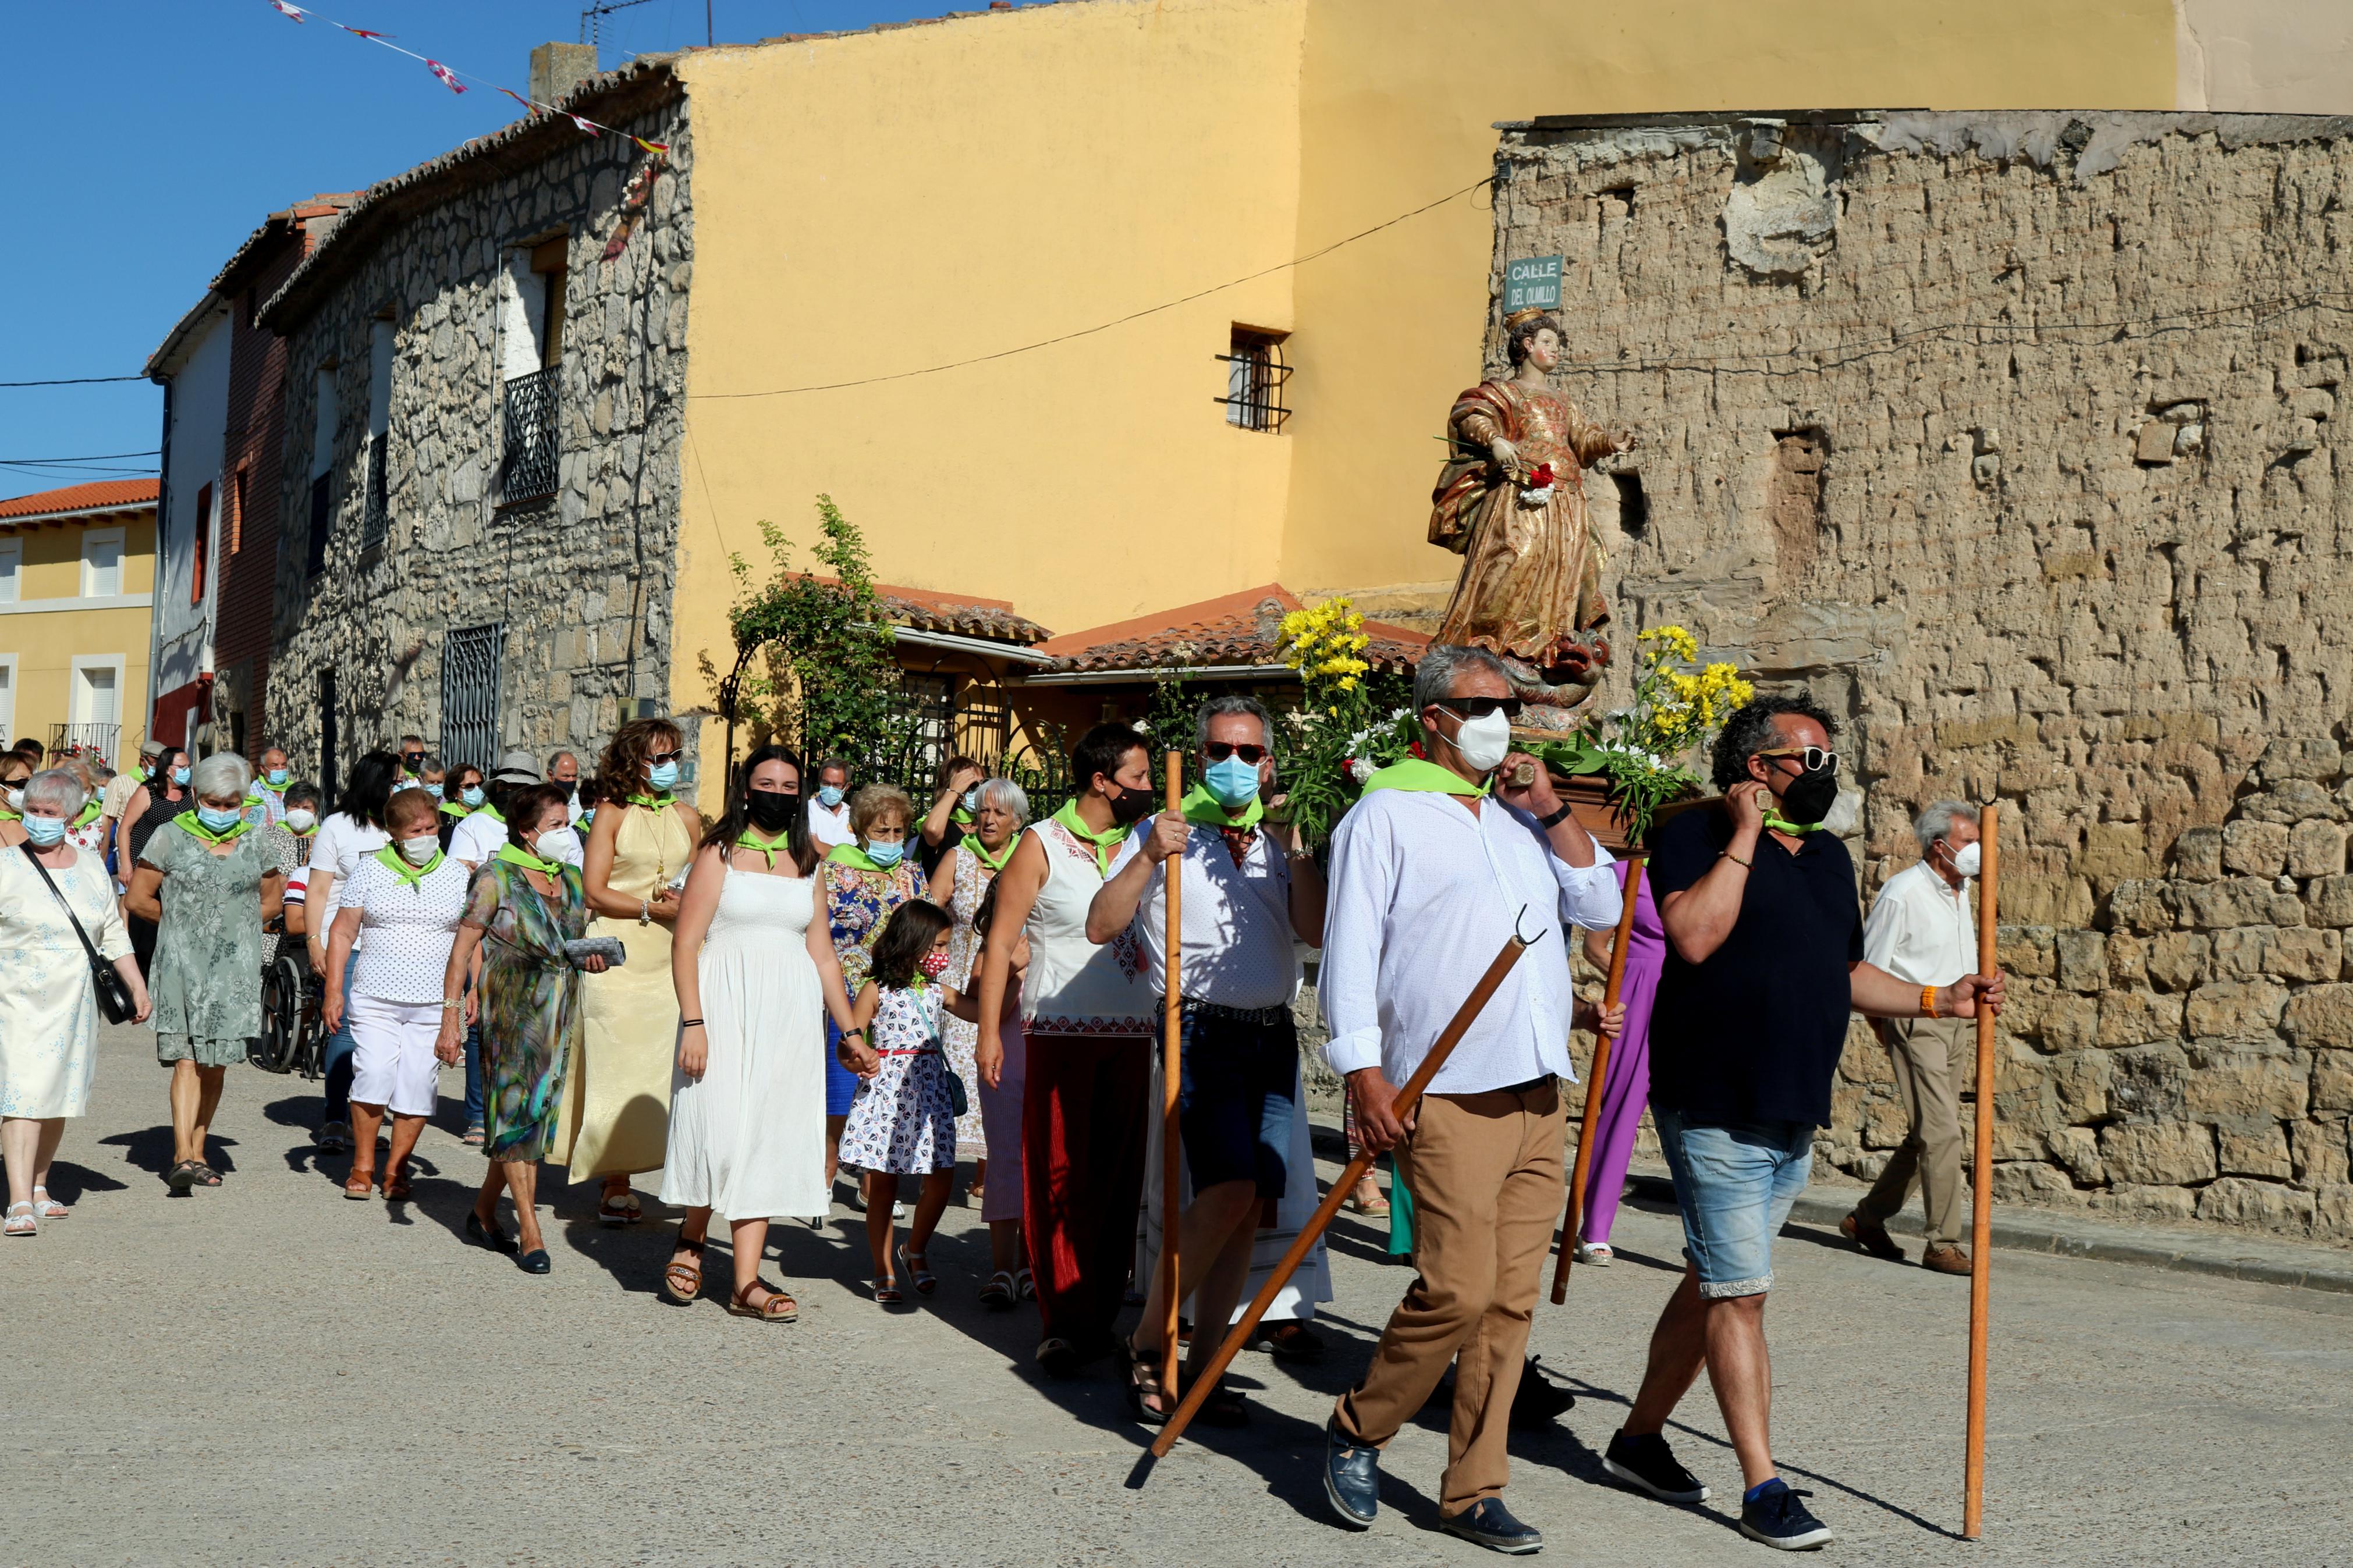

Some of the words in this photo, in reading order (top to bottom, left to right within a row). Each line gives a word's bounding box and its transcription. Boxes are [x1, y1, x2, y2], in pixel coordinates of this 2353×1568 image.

[1512, 262, 1557, 280] CALLE
[1511, 288, 1524, 306] DEL
[1527, 285, 1556, 305] OLMILLO
[684, 765, 689, 778] 4
